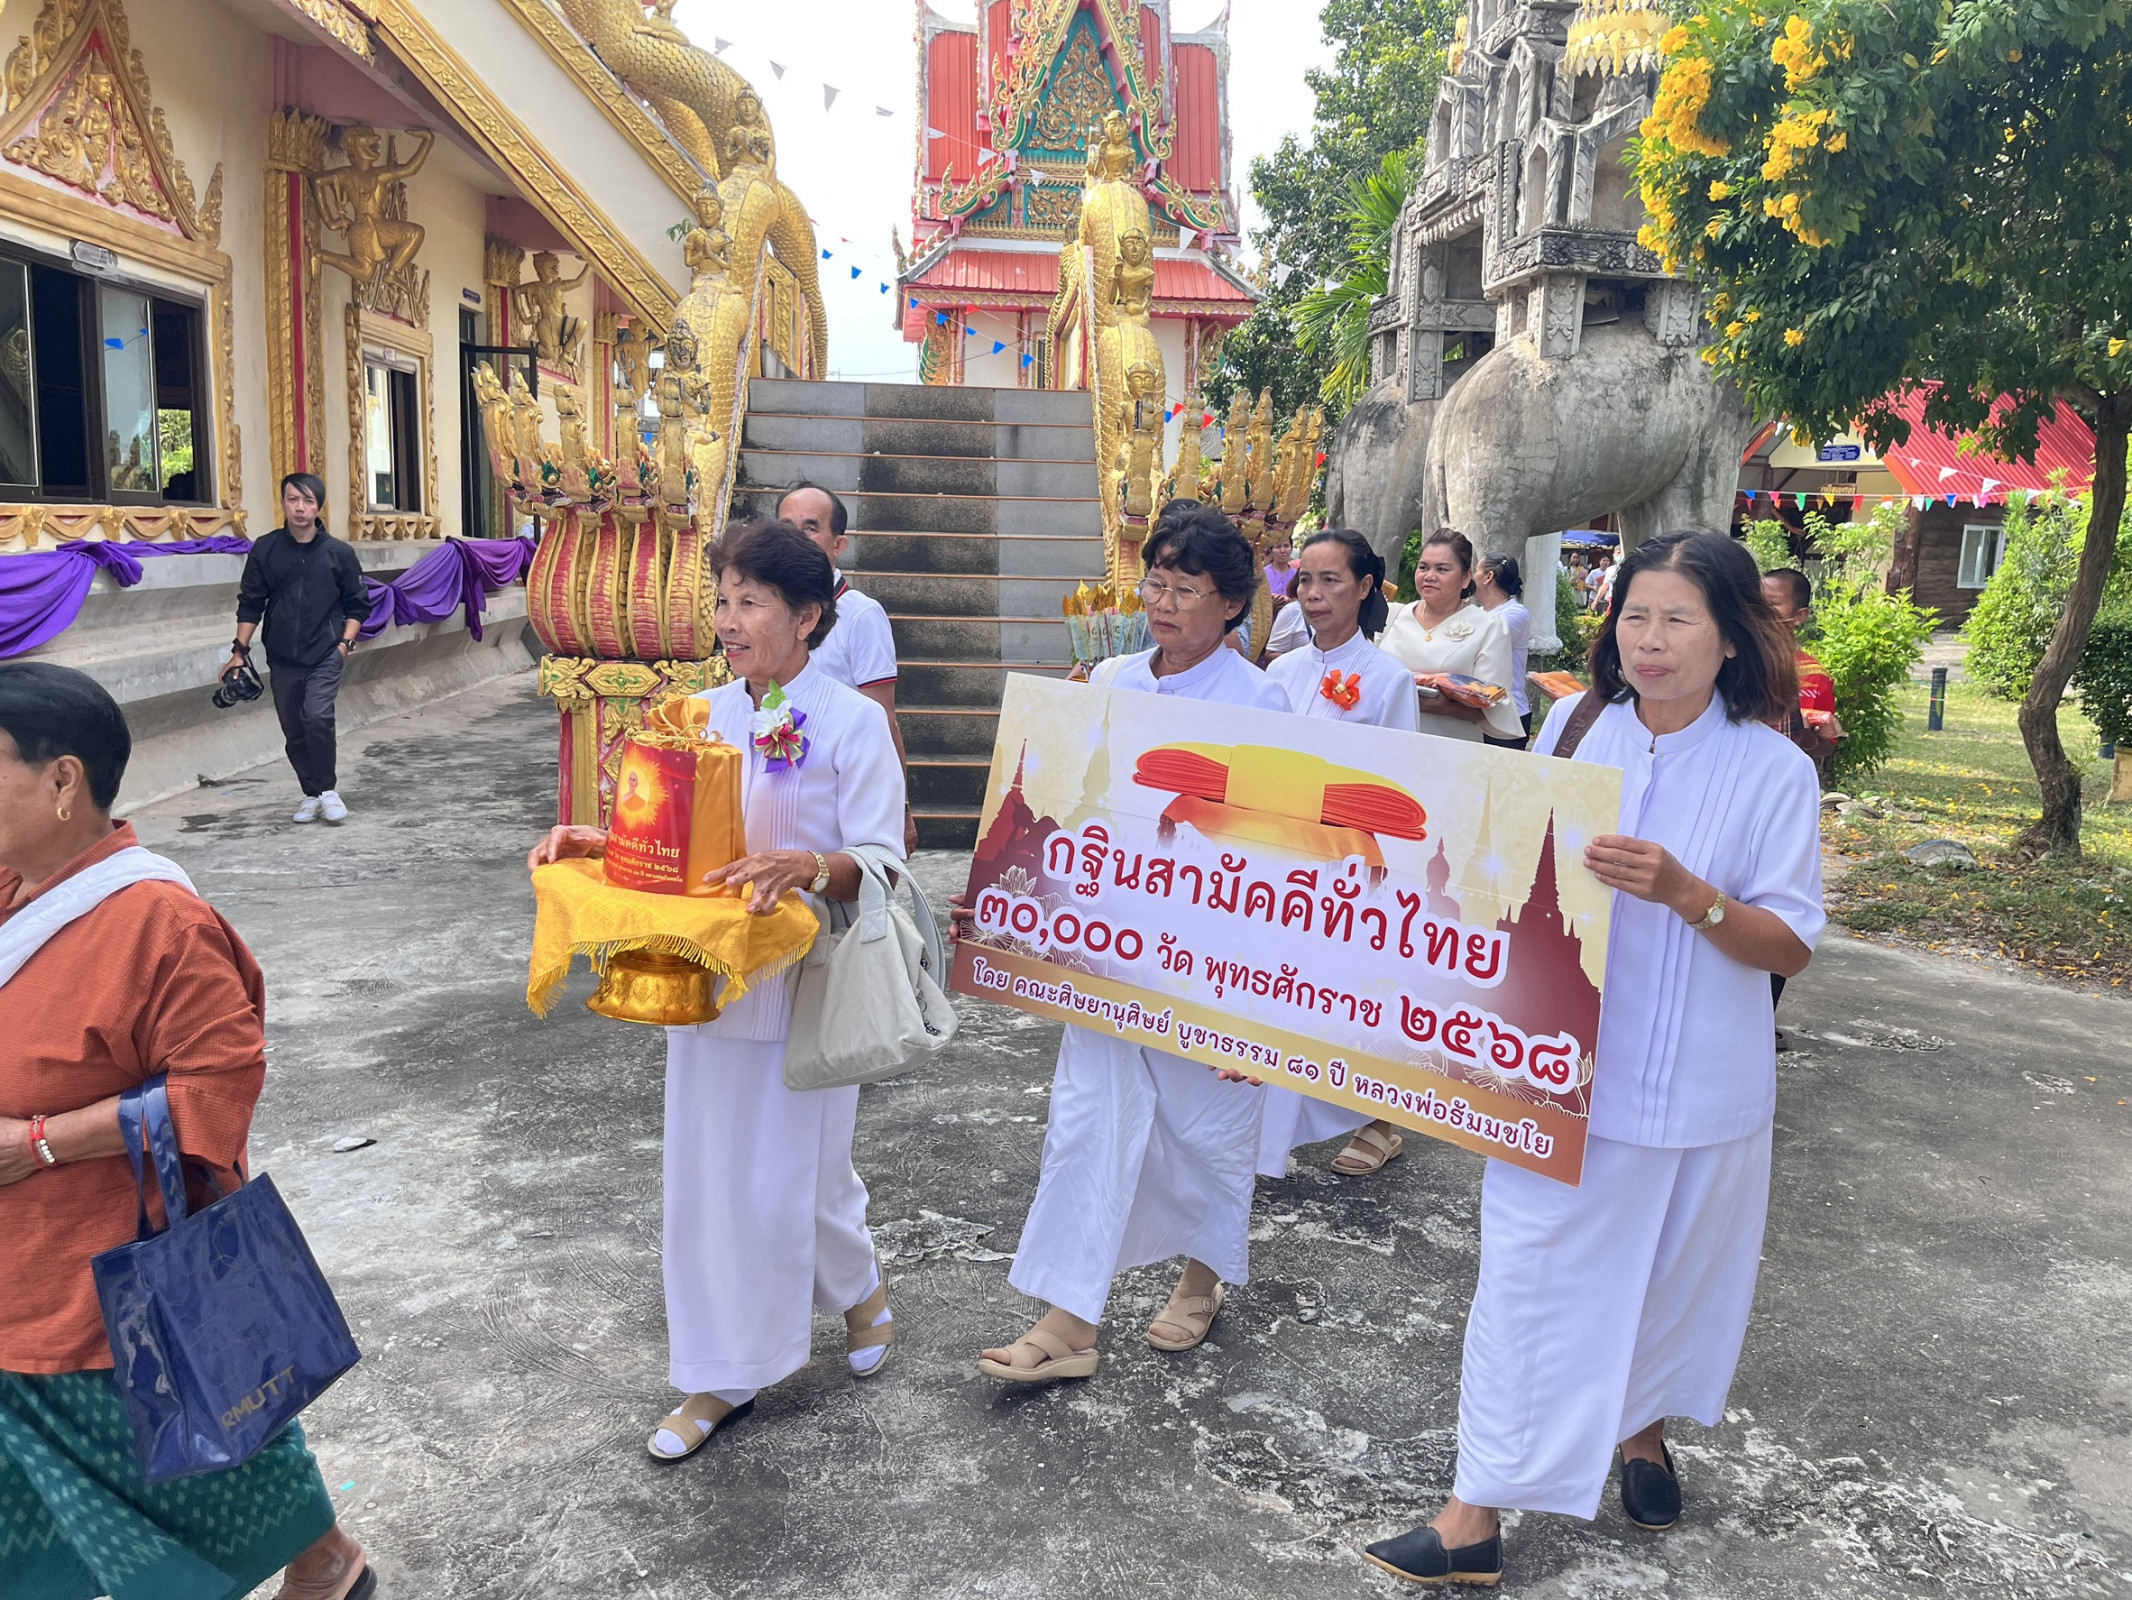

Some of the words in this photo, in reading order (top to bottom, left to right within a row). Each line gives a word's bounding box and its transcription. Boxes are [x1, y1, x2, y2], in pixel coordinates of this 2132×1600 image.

[979, 893, 1144, 962] ๓๐,๐๐๐
[1156, 931, 1194, 976] วัด
[1204, 955, 1384, 1029] พุทธศักราช
[1399, 994, 1573, 1086] ๒๕๖๘
[1049, 824, 1502, 981] กฐินสามัคคีทั่วไทย
[974, 959, 1009, 989] โดย
[1014, 976, 1172, 1034] คณะศิษยานุศิษย์
[1177, 1022, 1280, 1067] บูชาธรรม
[1287, 1056, 1320, 1081] ๘๑
[1329, 1060, 1346, 1088] ปี
[1354, 1074, 1552, 1156] หลวงพ่อธัมมชโย
[221, 1363, 296, 1432] RMUTT
